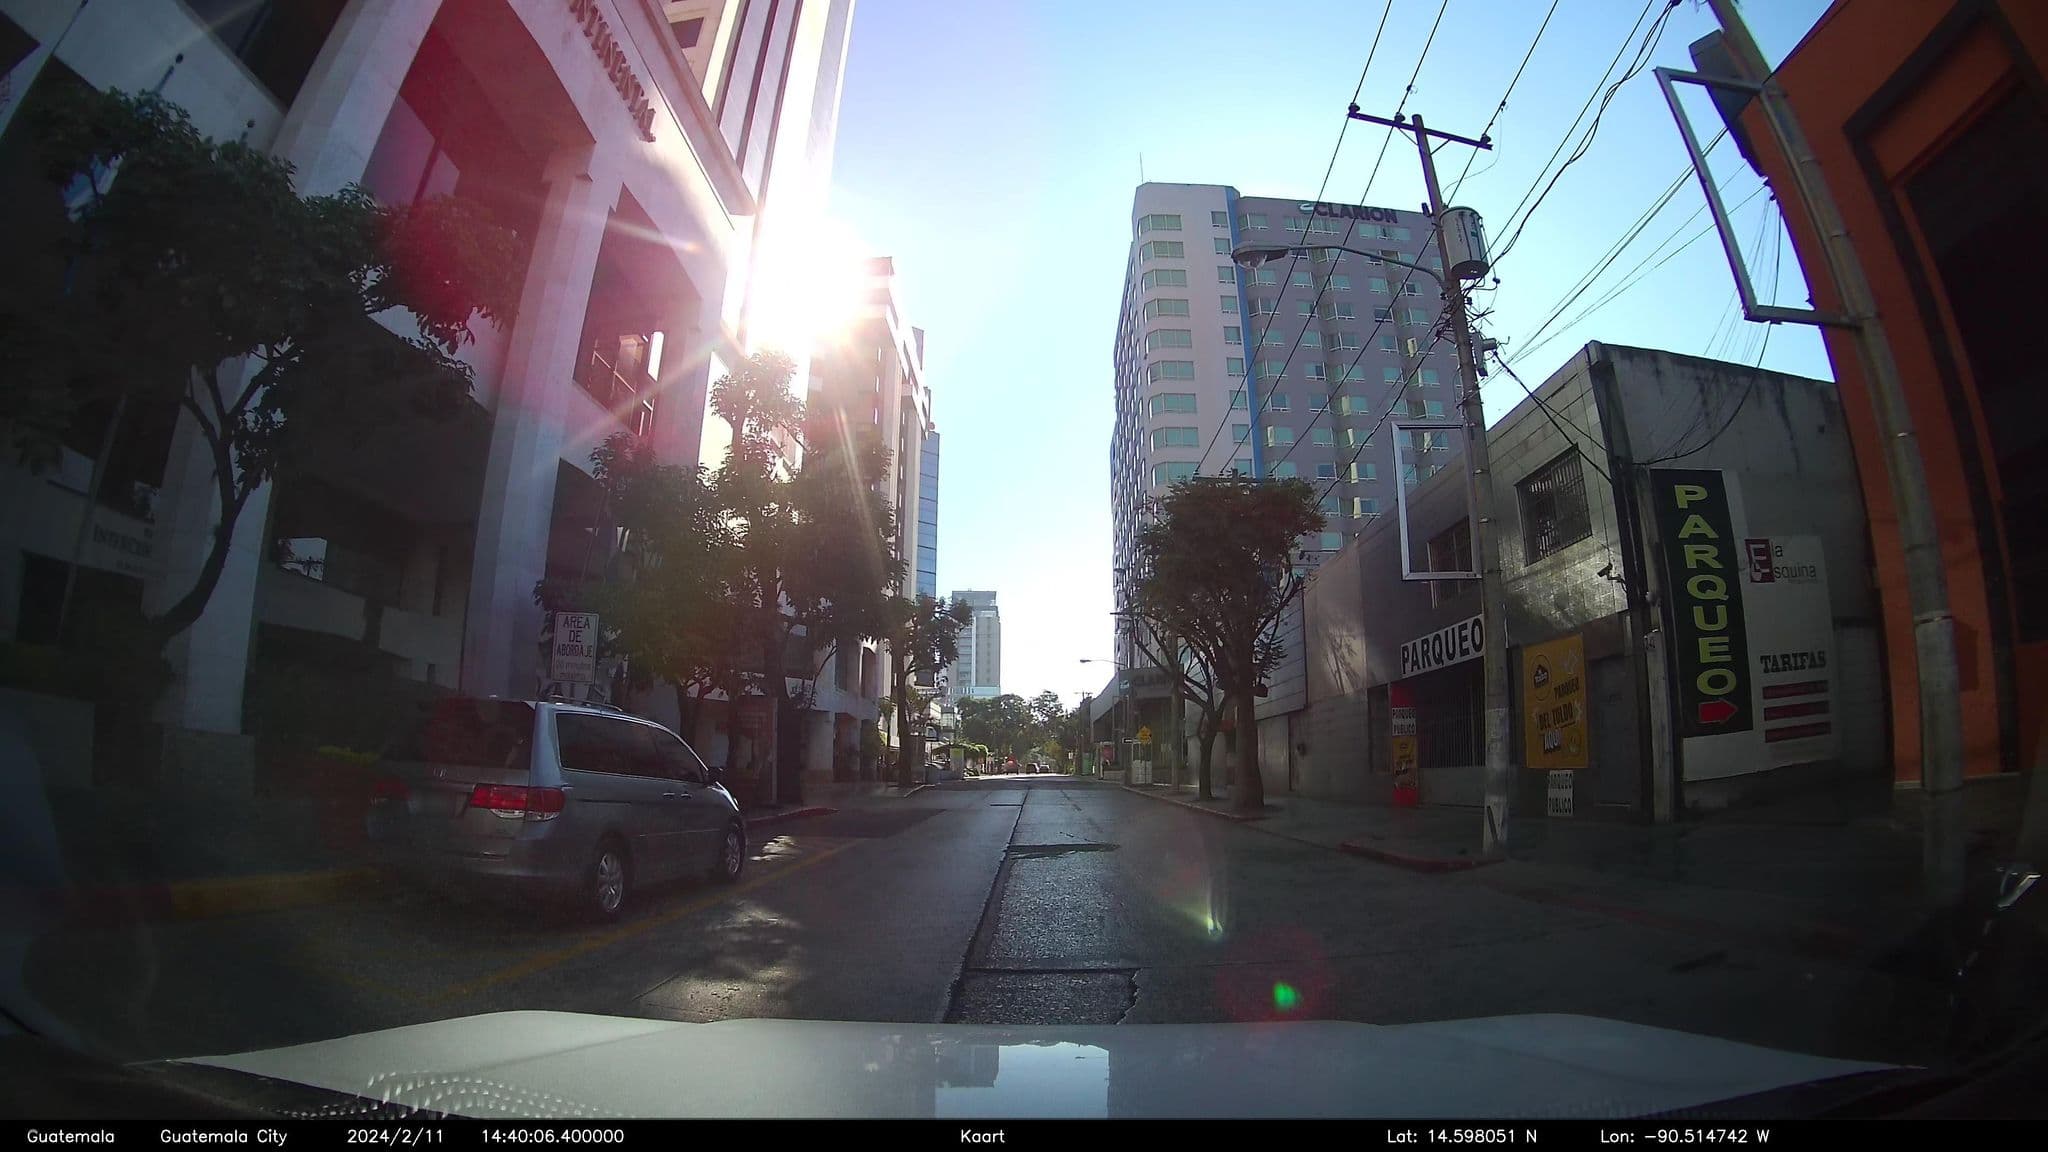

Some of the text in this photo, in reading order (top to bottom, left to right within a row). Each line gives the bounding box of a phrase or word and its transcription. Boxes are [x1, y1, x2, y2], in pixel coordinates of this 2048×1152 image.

[1314, 204, 1397, 223] CLARION
[1673, 484, 1737, 696] PARQUEO
[564, 616, 590, 629] AREA
[569, 630, 582, 642] DE
[557, 644, 592, 657] ABORDAJE
[1402, 618, 1484, 675] PARQUEO
[1760, 651, 1828, 673] TARIFAS
[1554, 676, 1579, 700] PARQUEO
